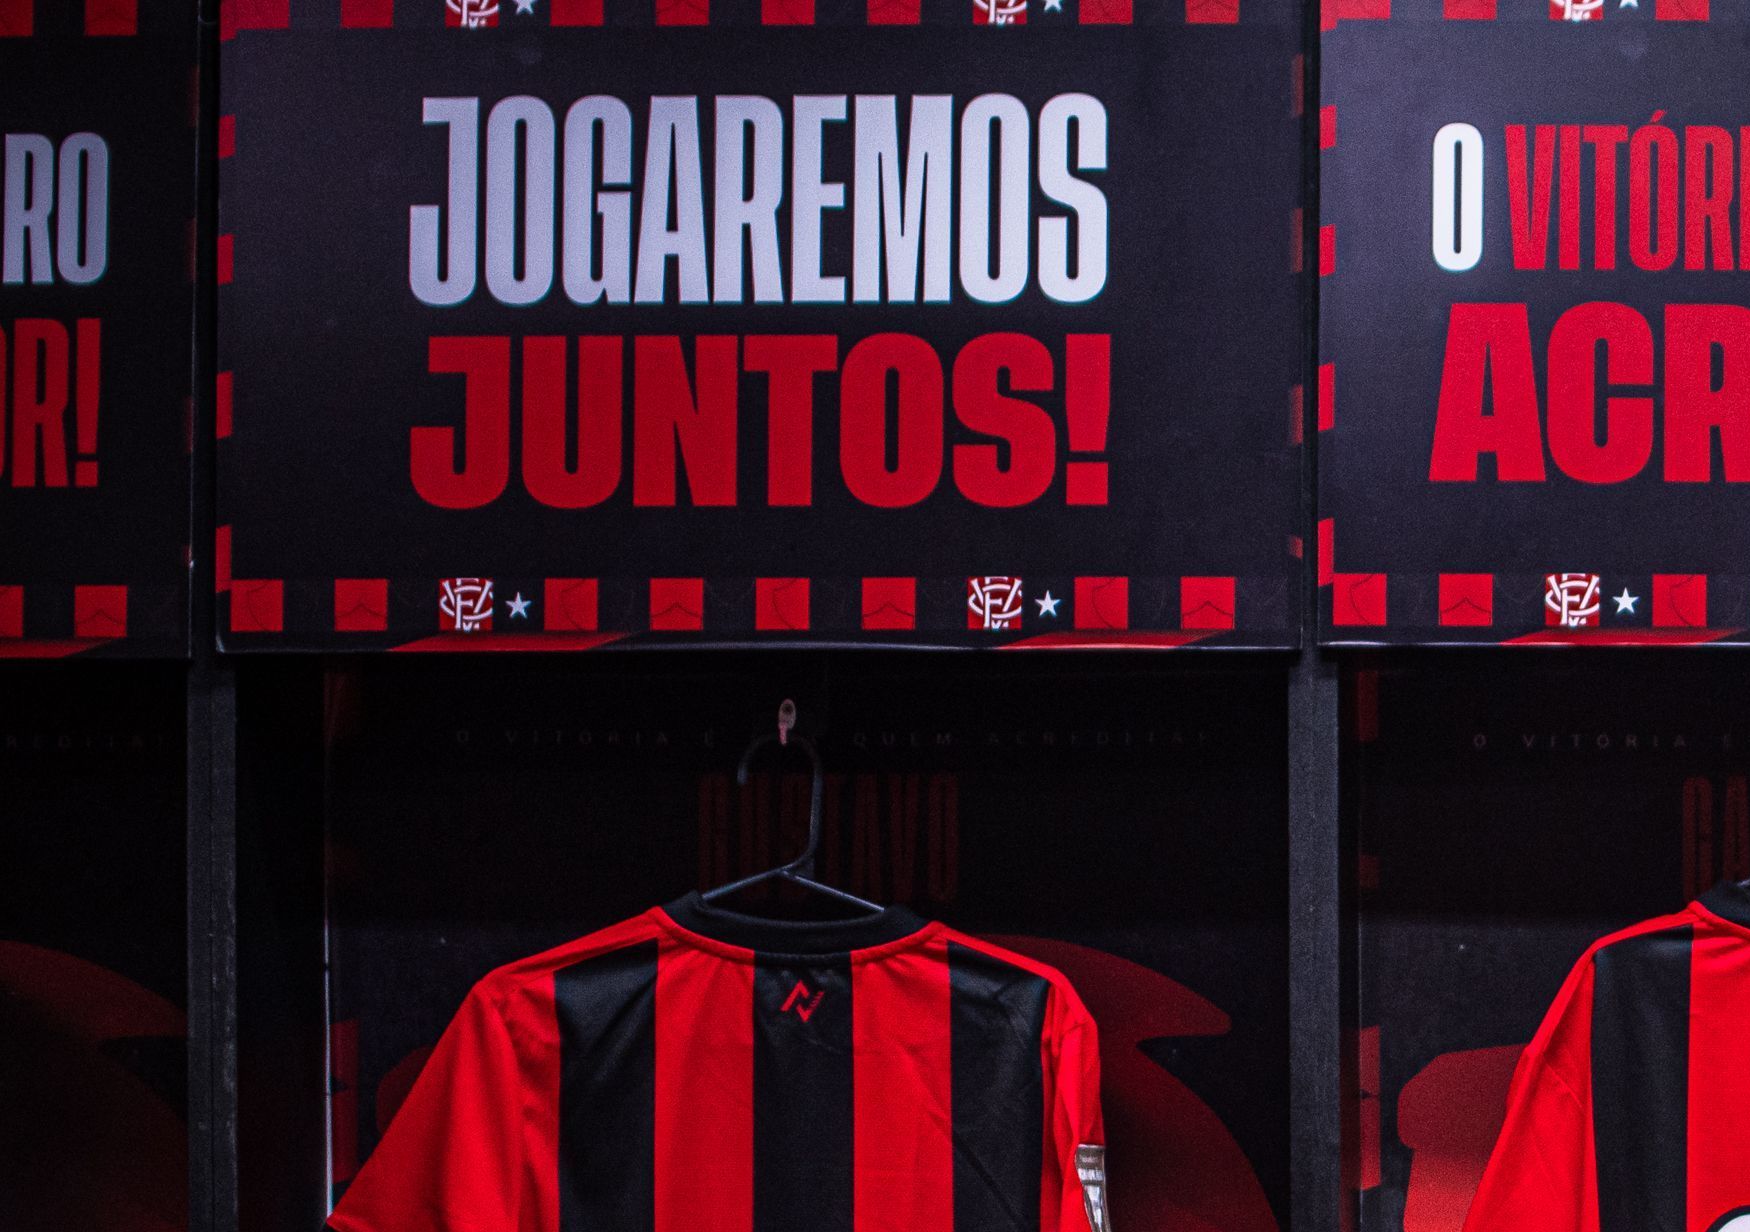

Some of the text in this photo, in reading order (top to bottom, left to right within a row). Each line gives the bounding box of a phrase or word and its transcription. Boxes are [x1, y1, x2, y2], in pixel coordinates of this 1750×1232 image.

[409, 93, 1109, 306] JOGAREMOS
[1432, 121, 1484, 272] O
[0, 315, 102, 489] R!
[410, 331, 1112, 510] JUNTOS!
